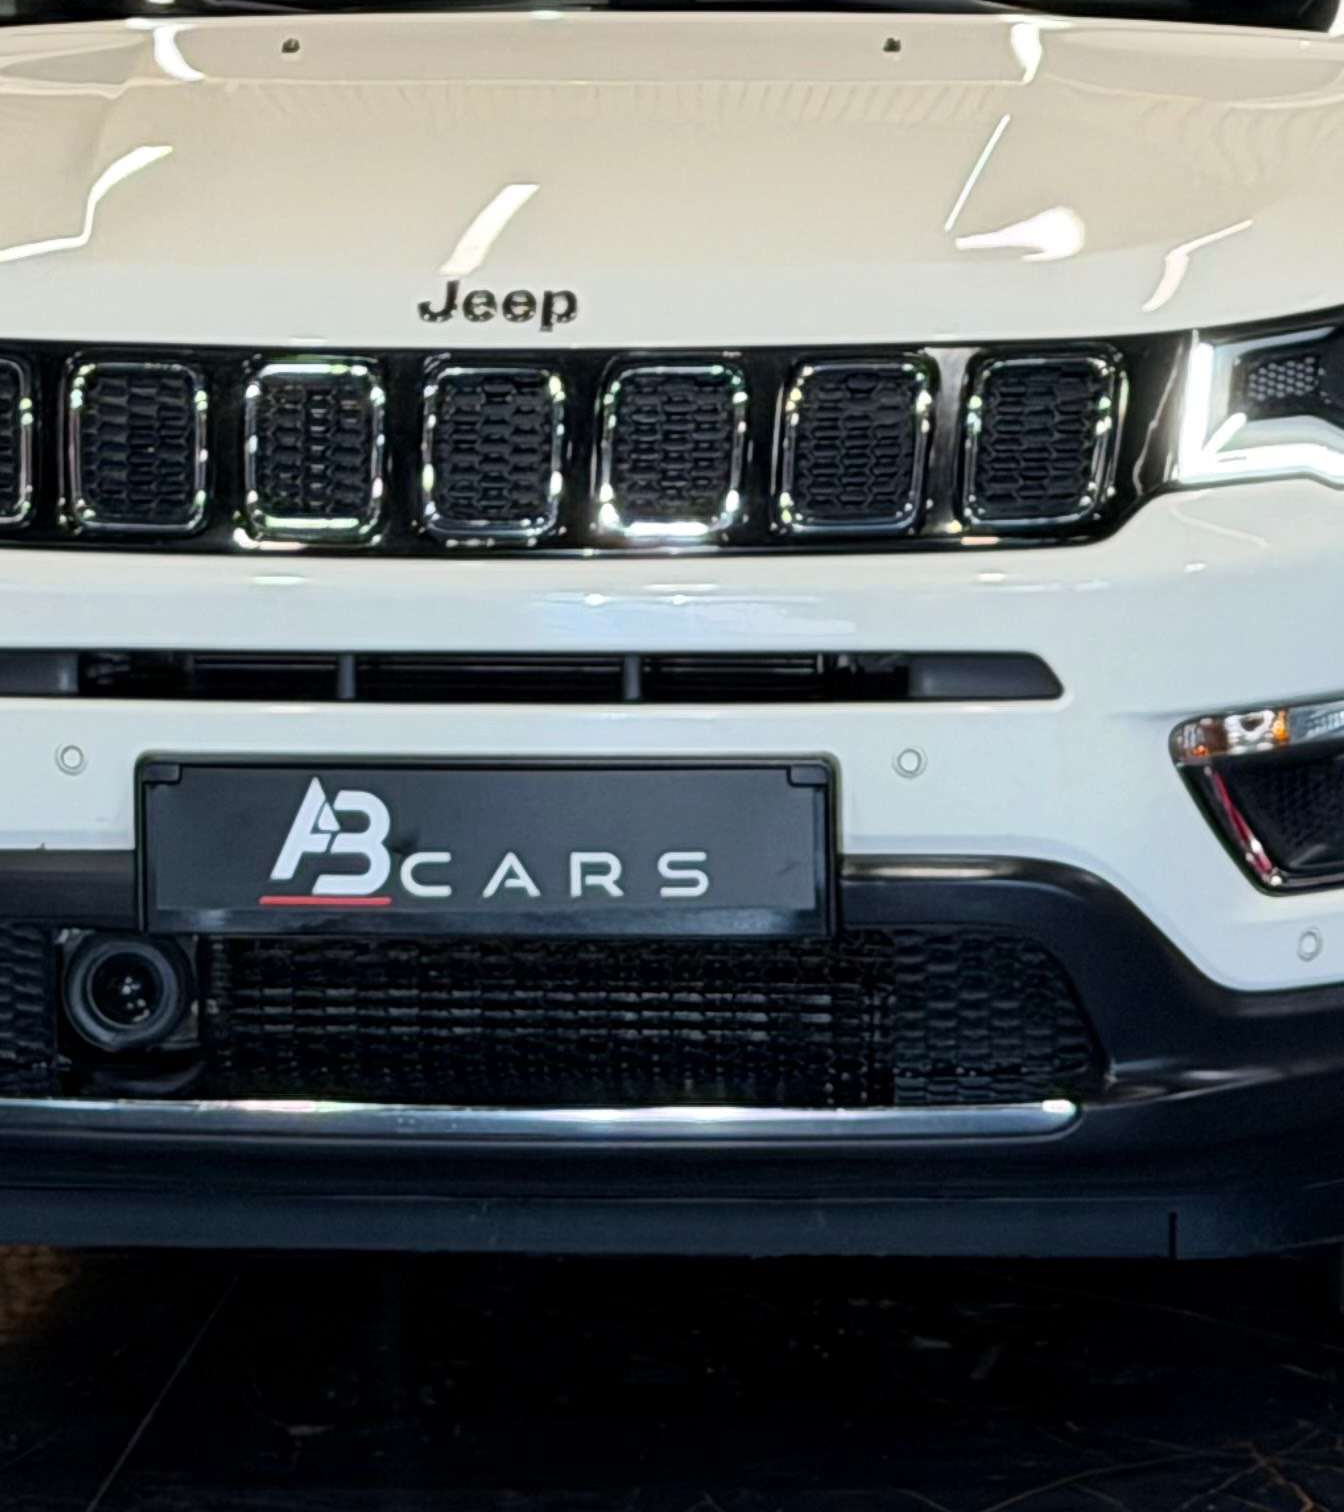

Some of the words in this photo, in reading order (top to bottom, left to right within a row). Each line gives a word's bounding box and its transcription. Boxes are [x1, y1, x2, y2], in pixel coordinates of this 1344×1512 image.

[417, 279, 578, 332] Jeep
[269, 776, 392, 896] AB
[399, 850, 710, 899] CARS
